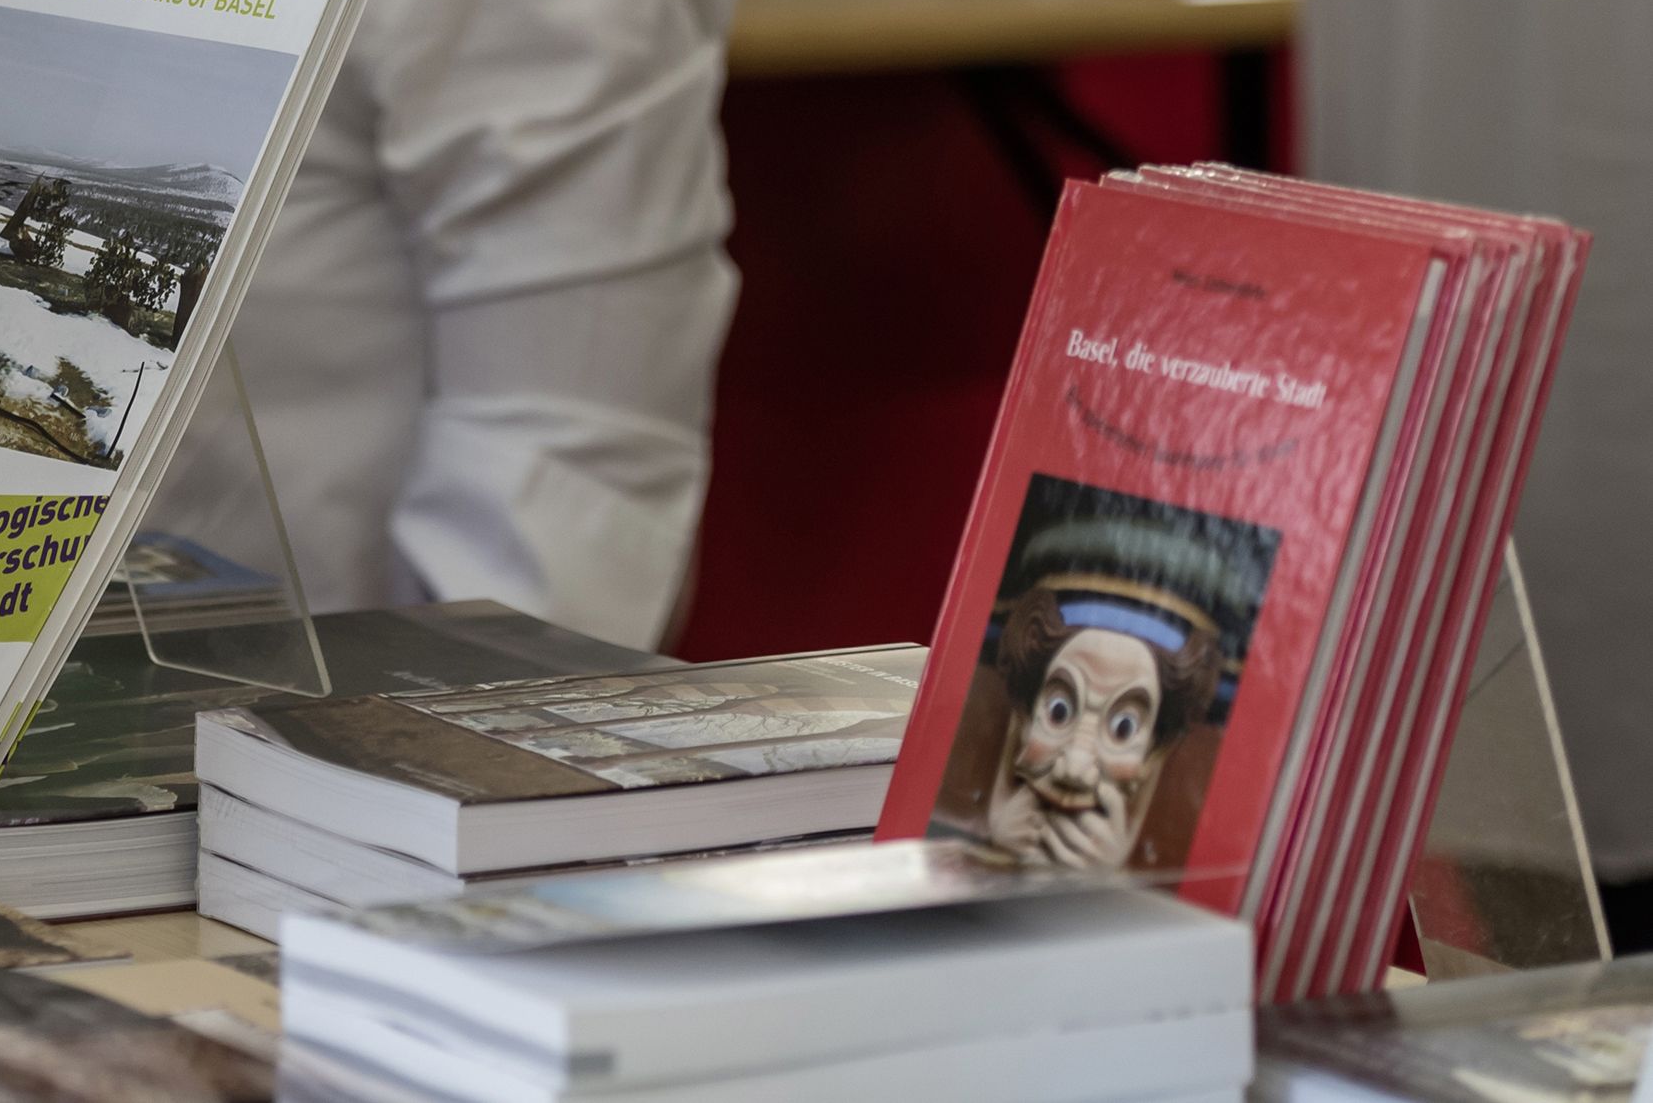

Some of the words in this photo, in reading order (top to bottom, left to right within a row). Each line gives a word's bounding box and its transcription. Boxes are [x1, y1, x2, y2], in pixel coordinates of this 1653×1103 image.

[1066, 329, 1117, 369] Basel,
[1125, 342, 1155, 374] die
[1160, 354, 1270, 397] verzauberte
[1276, 371, 1327, 409] Stadt
